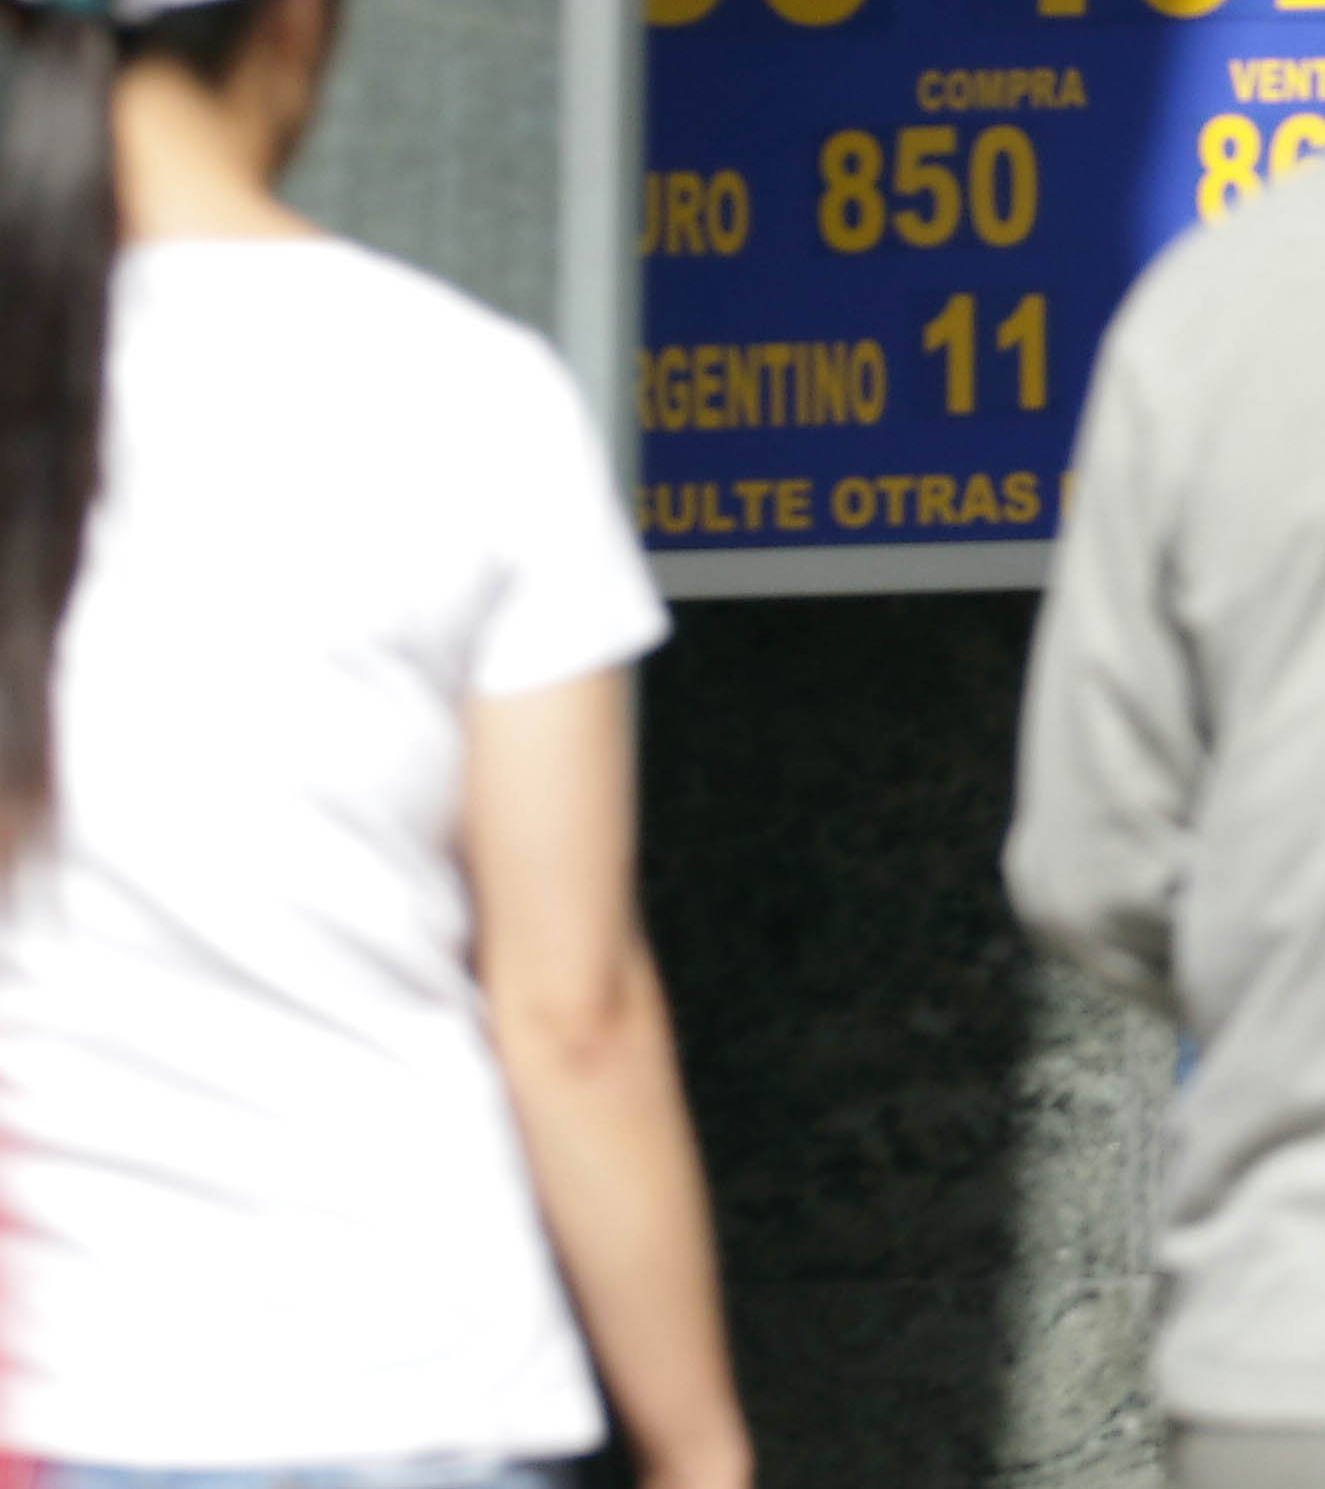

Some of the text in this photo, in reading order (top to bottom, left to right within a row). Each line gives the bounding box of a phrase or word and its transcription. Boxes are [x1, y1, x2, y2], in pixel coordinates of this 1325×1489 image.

[916, 68, 1087, 110] COMPRA
[817, 124, 1039, 254] 850
[921, 291, 1049, 415] 11
[831, 471, 1042, 527] OTRAS
